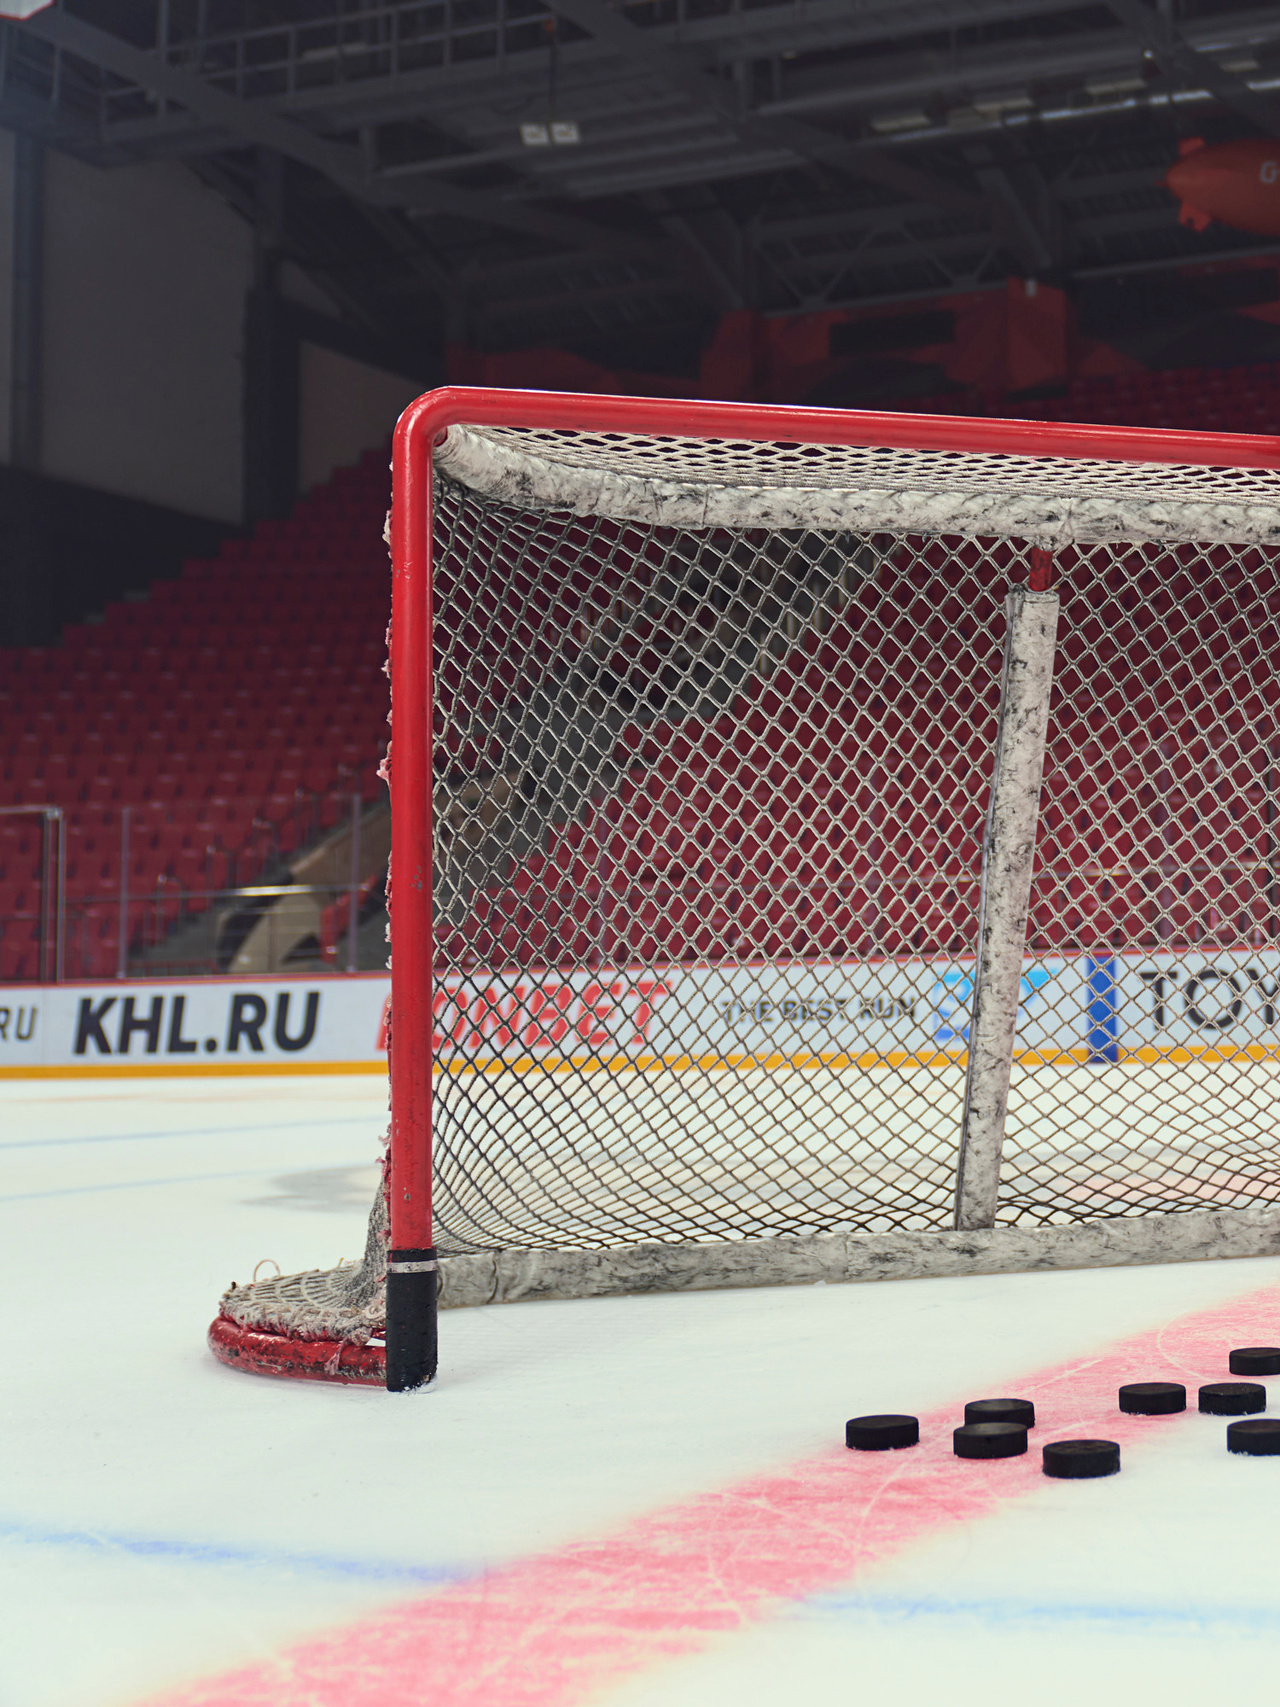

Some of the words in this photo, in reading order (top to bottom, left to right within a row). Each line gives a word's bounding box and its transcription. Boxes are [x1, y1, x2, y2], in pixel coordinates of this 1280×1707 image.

[73, 991, 320, 1055] KHL.RU
[721, 1000, 773, 1024] THE
[779, 999, 849, 1023] BEST
[860, 997, 917, 1021] RUN
